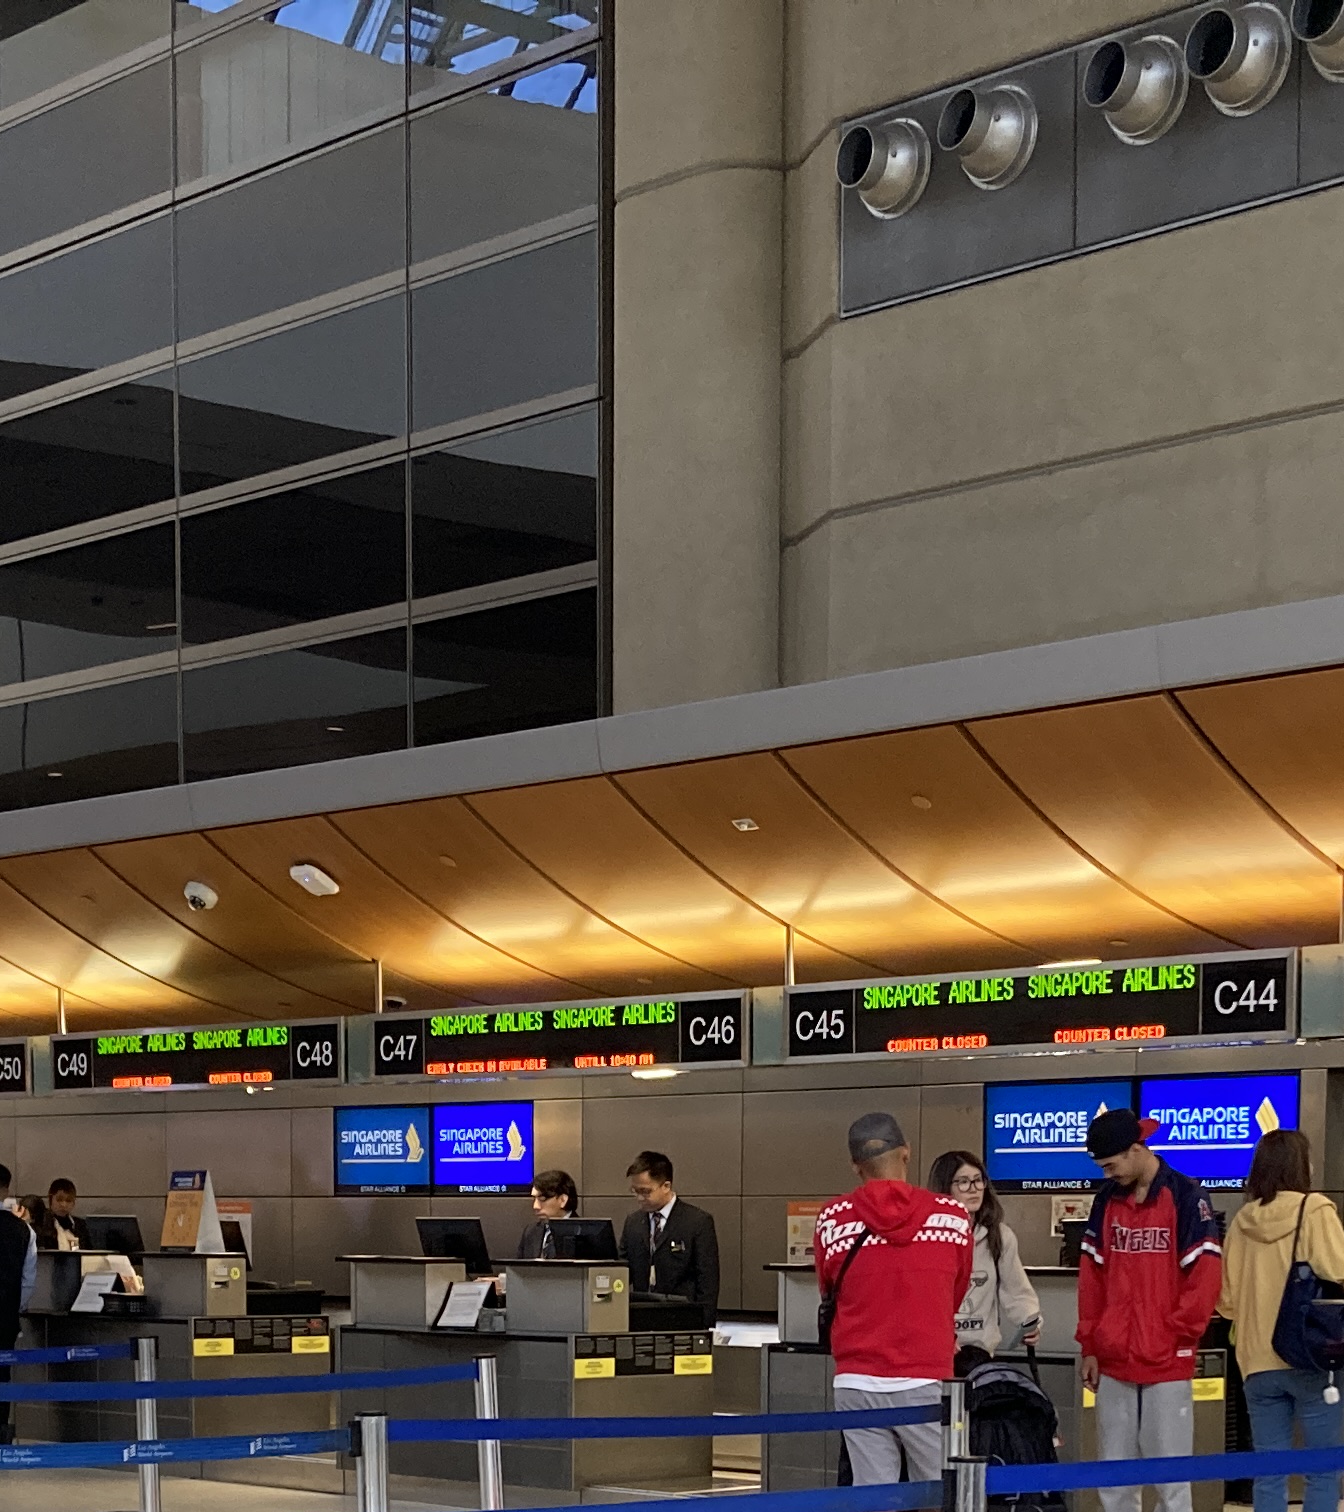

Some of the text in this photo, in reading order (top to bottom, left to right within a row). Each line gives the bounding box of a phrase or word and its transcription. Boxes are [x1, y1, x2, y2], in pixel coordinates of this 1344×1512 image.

[863, 964, 1196, 1010] SINGAPORE AIRLINES SINGAPORE AIRLINES
[1213, 979, 1278, 1015] C44
[430, 1002, 675, 1037] SINGAPORE AIRLINES SINGAPORE AIRLINES
[689, 1015, 735, 1046] C46
[795, 1010, 845, 1041] C45
[97, 1026, 288, 1055] SINGAPORE AIRLINES SINGAPORE AIRLINES
[379, 1035, 417, 1061] C47
[887, 1025, 1166, 1053] COUNTER CLOSED COUNTER CLOSED
[57, 1053, 87, 1077] C49
[296, 1041, 333, 1067] C48
[994, 1111, 1087, 1129] SINGAPORE
[1148, 1106, 1250, 1126] SINGAPORE
[341, 1130, 403, 1143] SINGAPORE
[439, 1128, 503, 1142] SINGAPORE
[1012, 1127, 1087, 1144] AIRLINES
[1168, 1123, 1250, 1141] AIRLINES
[353, 1143, 403, 1156] AIRLINES
[452, 1141, 503, 1154] AIRLINES
[1022, 1180, 1083, 1190] STAR ALLIANCE
[1200, 1179, 1243, 1189] ALLIANCE
